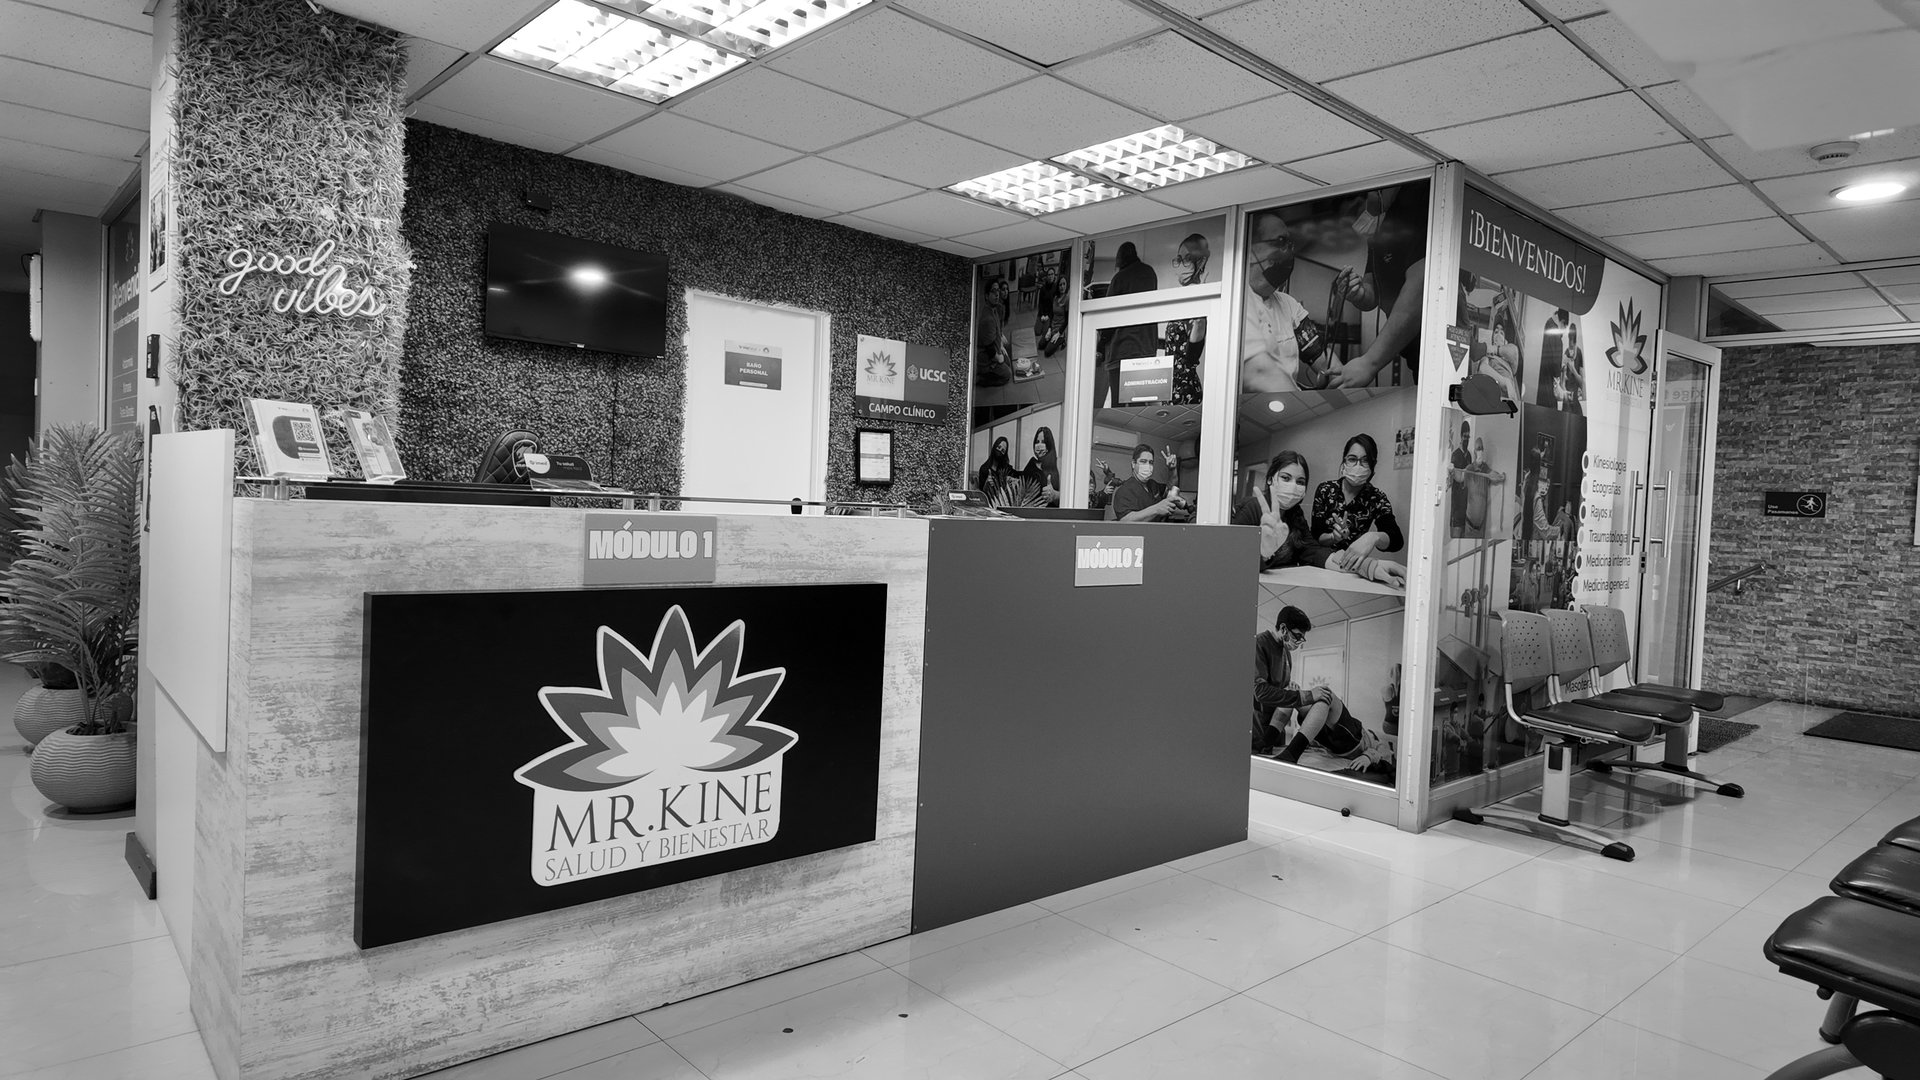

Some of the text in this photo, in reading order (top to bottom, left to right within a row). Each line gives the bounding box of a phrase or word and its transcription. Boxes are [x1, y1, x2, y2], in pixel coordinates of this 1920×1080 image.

[1469, 209, 1587, 294] ¡BIENVENIDOS!
[219, 239, 336, 295] good
[272, 265, 387, 317] vibes
[739, 367, 769, 377] PERSONAL
[746, 361, 762, 369] BAÑO
[919, 367, 947, 383] UCSC
[1123, 377, 1168, 387] ADMINISTRACIÓN
[868, 402, 936, 419] CAMPO CLÍNICO
[1590, 504, 1608, 522] Rayos
[588, 519, 713, 560] MÓDULO 1
[1077, 541, 1143, 569] MÓDULO 2
[1586, 554, 1631, 568] Medicina interna
[1582, 577, 1630, 594] Medicina general
[544, 818, 771, 882] SALUD Y BIENESTAR
